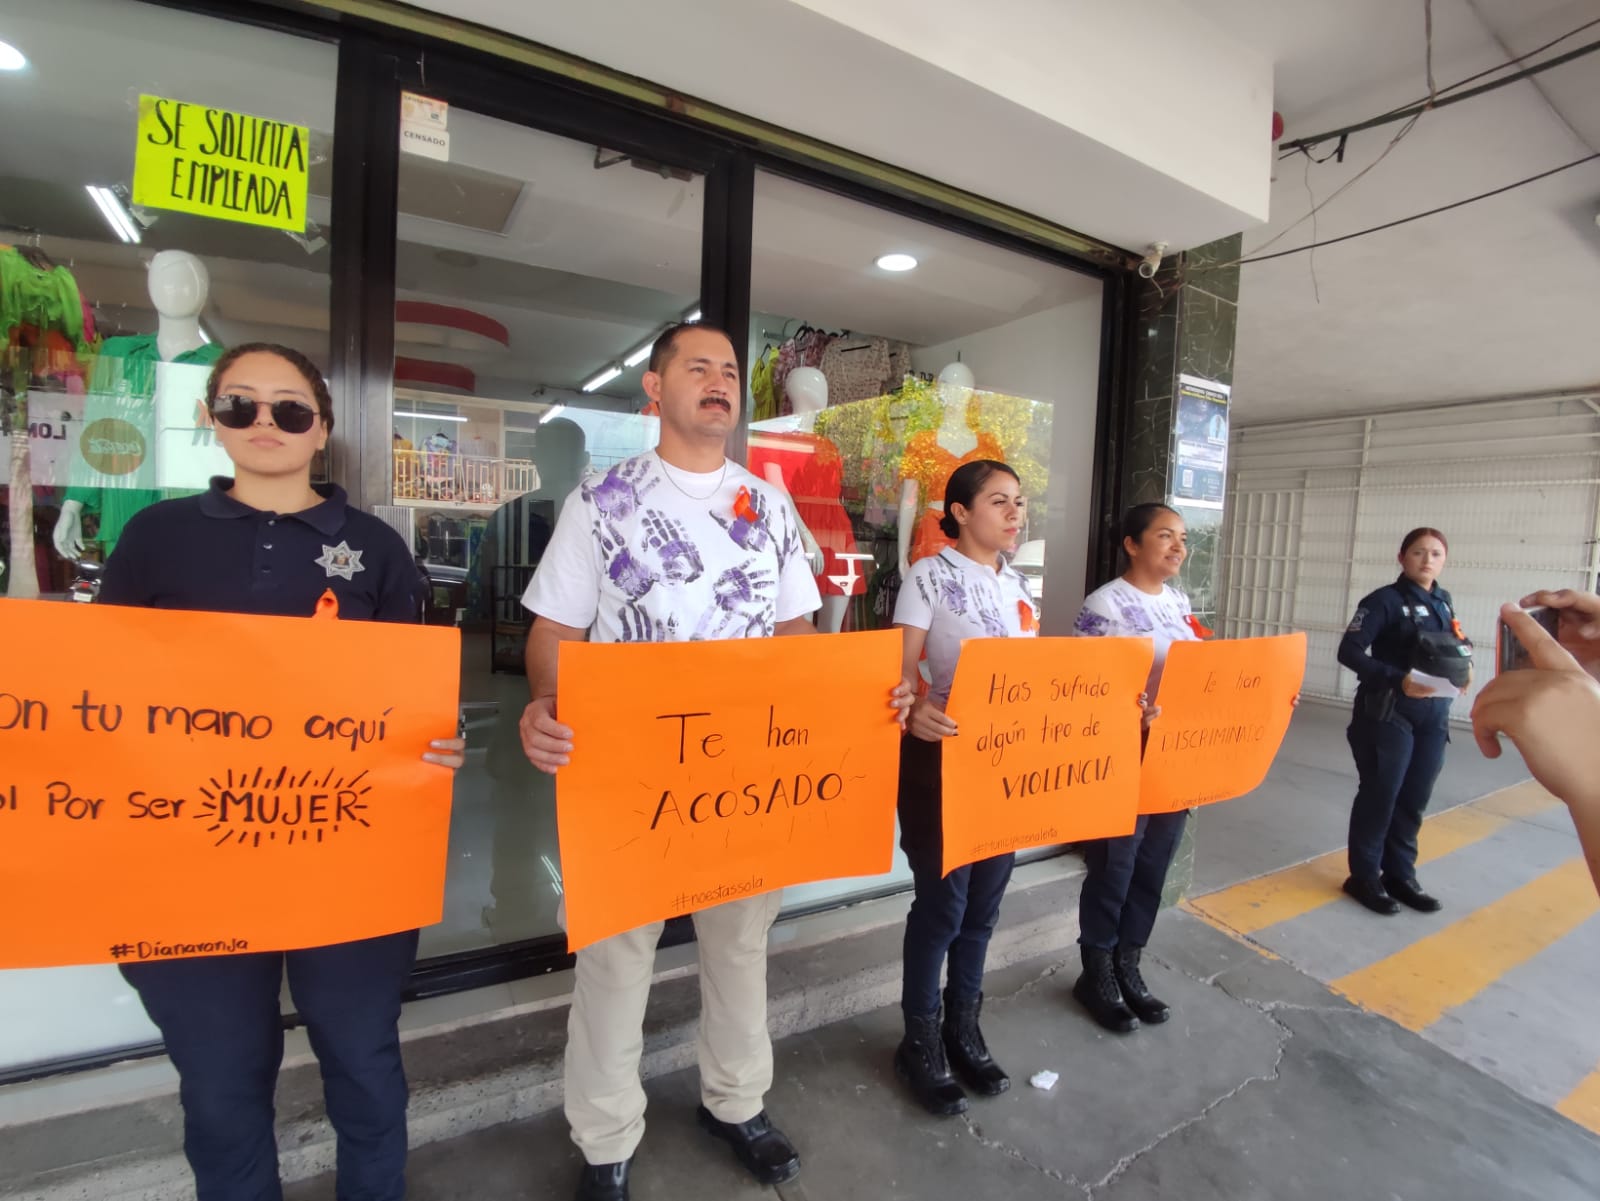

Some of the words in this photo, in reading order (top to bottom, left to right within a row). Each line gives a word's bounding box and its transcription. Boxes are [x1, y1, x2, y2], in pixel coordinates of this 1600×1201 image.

[147, 99, 190, 150] SE
[198, 108, 305, 173] SOLICITA
[403, 130, 446, 147] CENSADO
[170, 156, 293, 220] EMPLEADA
[988, 673, 1032, 705] Has
[1236, 669, 1262, 692] han
[72, 689, 123, 733] tu
[148, 703, 273, 740] mano
[303, 706, 396, 752] aquí
[655, 711, 726, 765] Te
[767, 704, 809, 748] han
[975, 719, 1026, 768] algún
[1041, 714, 1072, 746] tipo
[1082, 713, 1102, 738] de
[1161, 725, 1265, 753] DISCRIMINADO
[650, 772, 844, 830] ACOSADO
[1002, 754, 1116, 801] VIOLENCIA
[217, 789, 359, 826] MUJER
[671, 874, 764, 913] #noestassola
